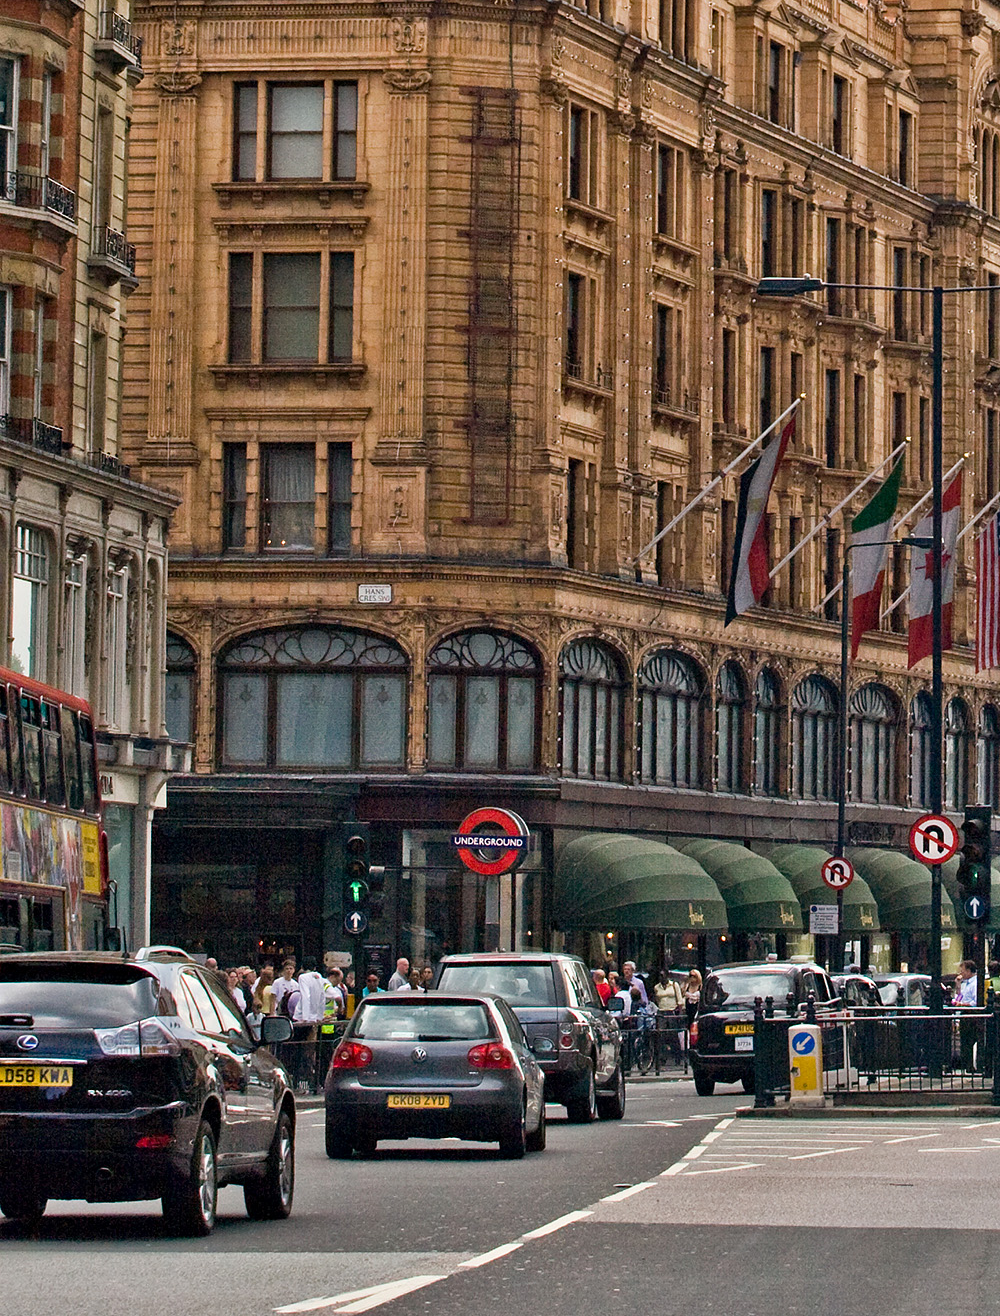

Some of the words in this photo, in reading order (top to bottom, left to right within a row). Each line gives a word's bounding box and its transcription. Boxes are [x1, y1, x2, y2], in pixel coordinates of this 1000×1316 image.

[454, 837, 523, 847] UNDERGROUND
[39, 1067, 70, 1084] KWA
[392, 1095, 421, 1106] GK08
[423, 1095, 445, 1106] ZYD
